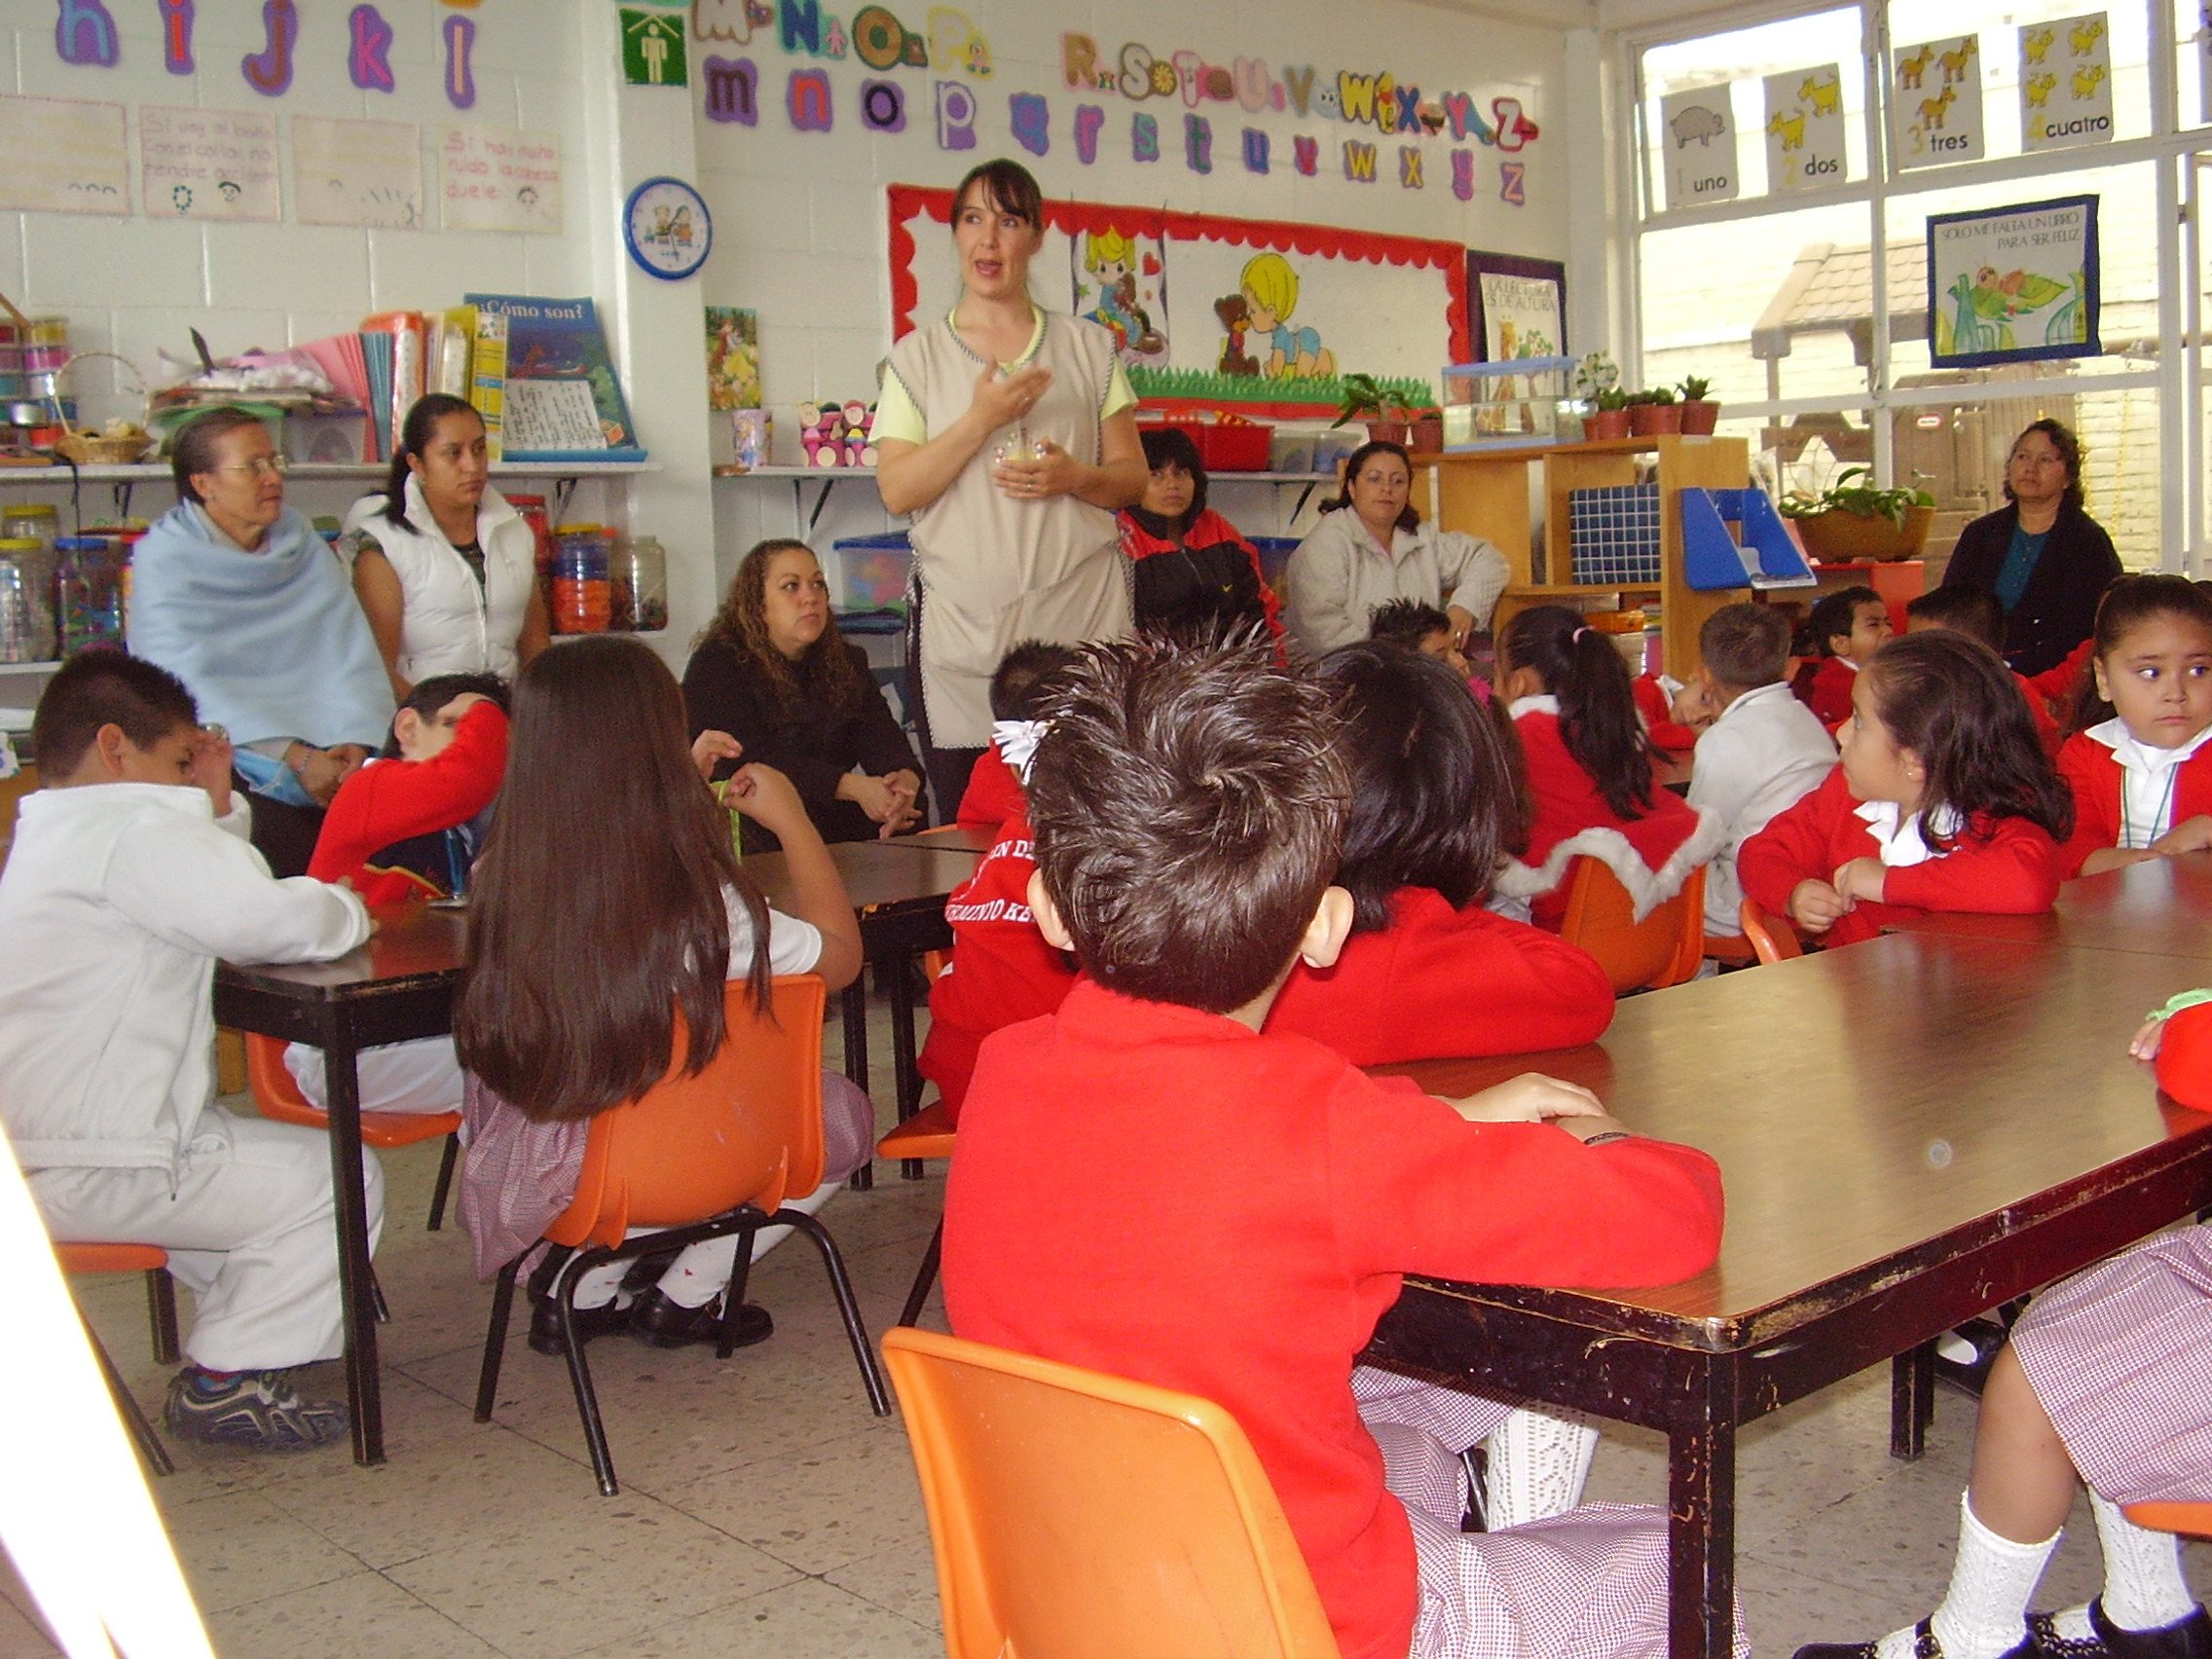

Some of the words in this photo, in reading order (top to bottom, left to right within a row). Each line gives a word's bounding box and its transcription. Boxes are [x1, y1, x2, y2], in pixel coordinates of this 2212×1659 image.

[779, 0, 821, 54] N
[854, 6, 903, 69] O
[1063, 33, 1098, 87] R
[1121, 44, 1152, 100] S
[1285, 66, 1313, 118] V
[1339, 70, 1375, 124] W
[1395, 86, 1421, 133] X
[1446, 92, 1471, 138] Y
[1493, 97, 1524, 151] Z
[793, 75, 828, 123] n
[2045, 114, 2110, 139] cuatro
[1907, 127, 1926, 155] 3
[1930, 132, 1969, 154] tres
[1784, 156, 1798, 185] 2
[1804, 154, 1838, 177] dos
[1693, 174, 1728, 194] uno
[1941, 227, 1972, 240] SOLO
[1974, 222, 1989, 236] ME
[1992, 220, 2027, 235] FALTA
[2028, 216, 2048, 230] UN
[1997, 236, 2028, 250] PARA
[2031, 233, 2050, 246] SER
[2052, 228, 2081, 243] FELIZ
[544, 304, 582, 318] son?
